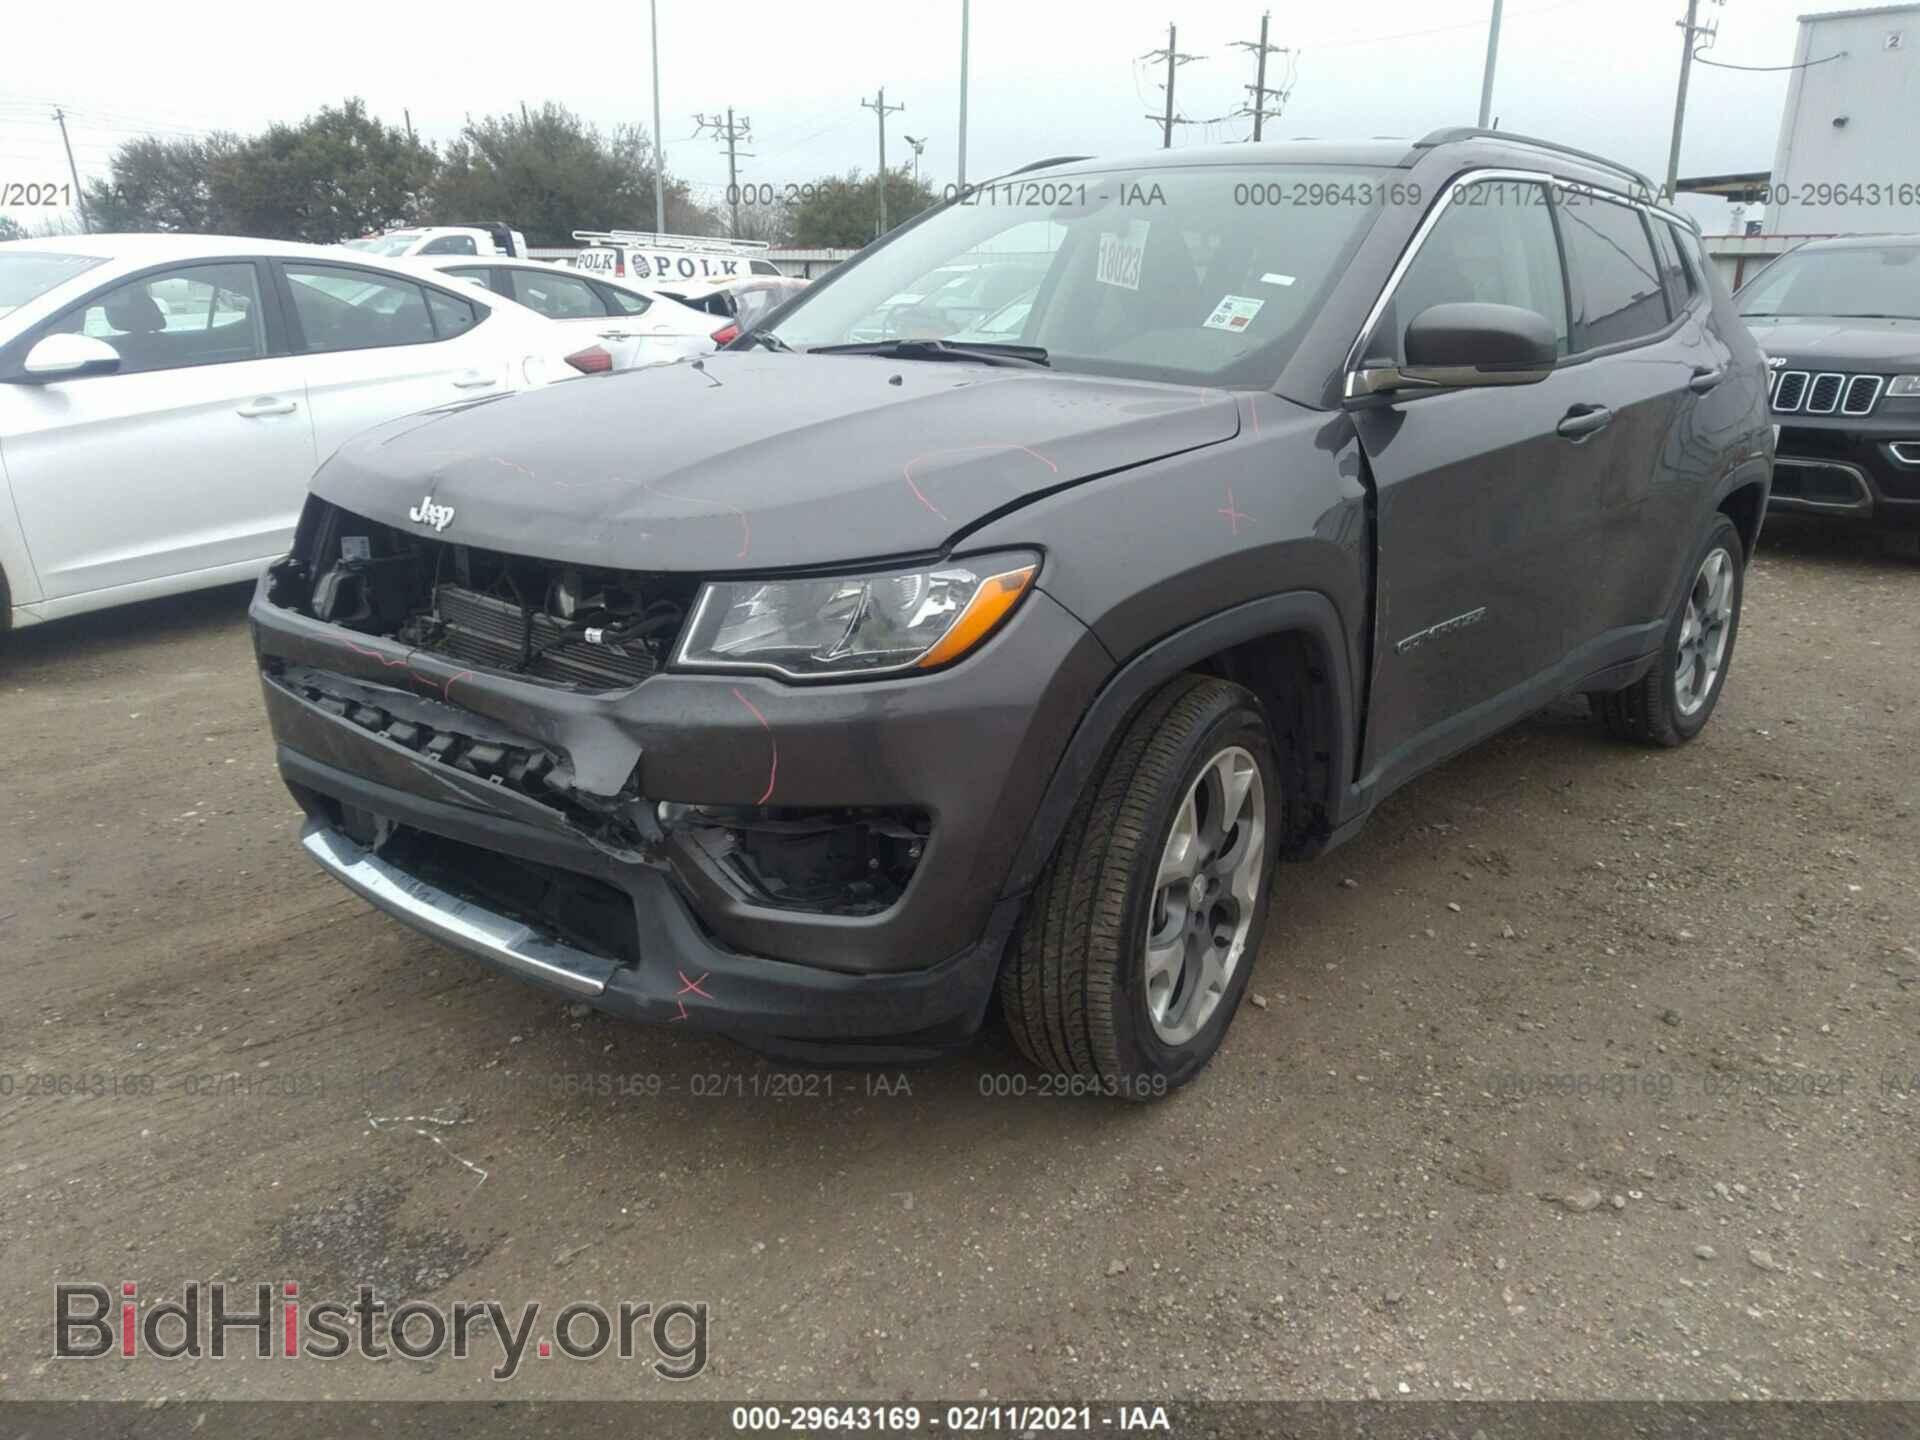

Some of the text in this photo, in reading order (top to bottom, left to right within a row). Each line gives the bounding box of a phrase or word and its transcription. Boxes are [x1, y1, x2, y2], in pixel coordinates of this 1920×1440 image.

[1888, 35, 1900, 48] 2
[577, 253, 615, 270] POLK
[653, 255, 738, 278] POLK
[409, 496, 455, 532] Jeep
